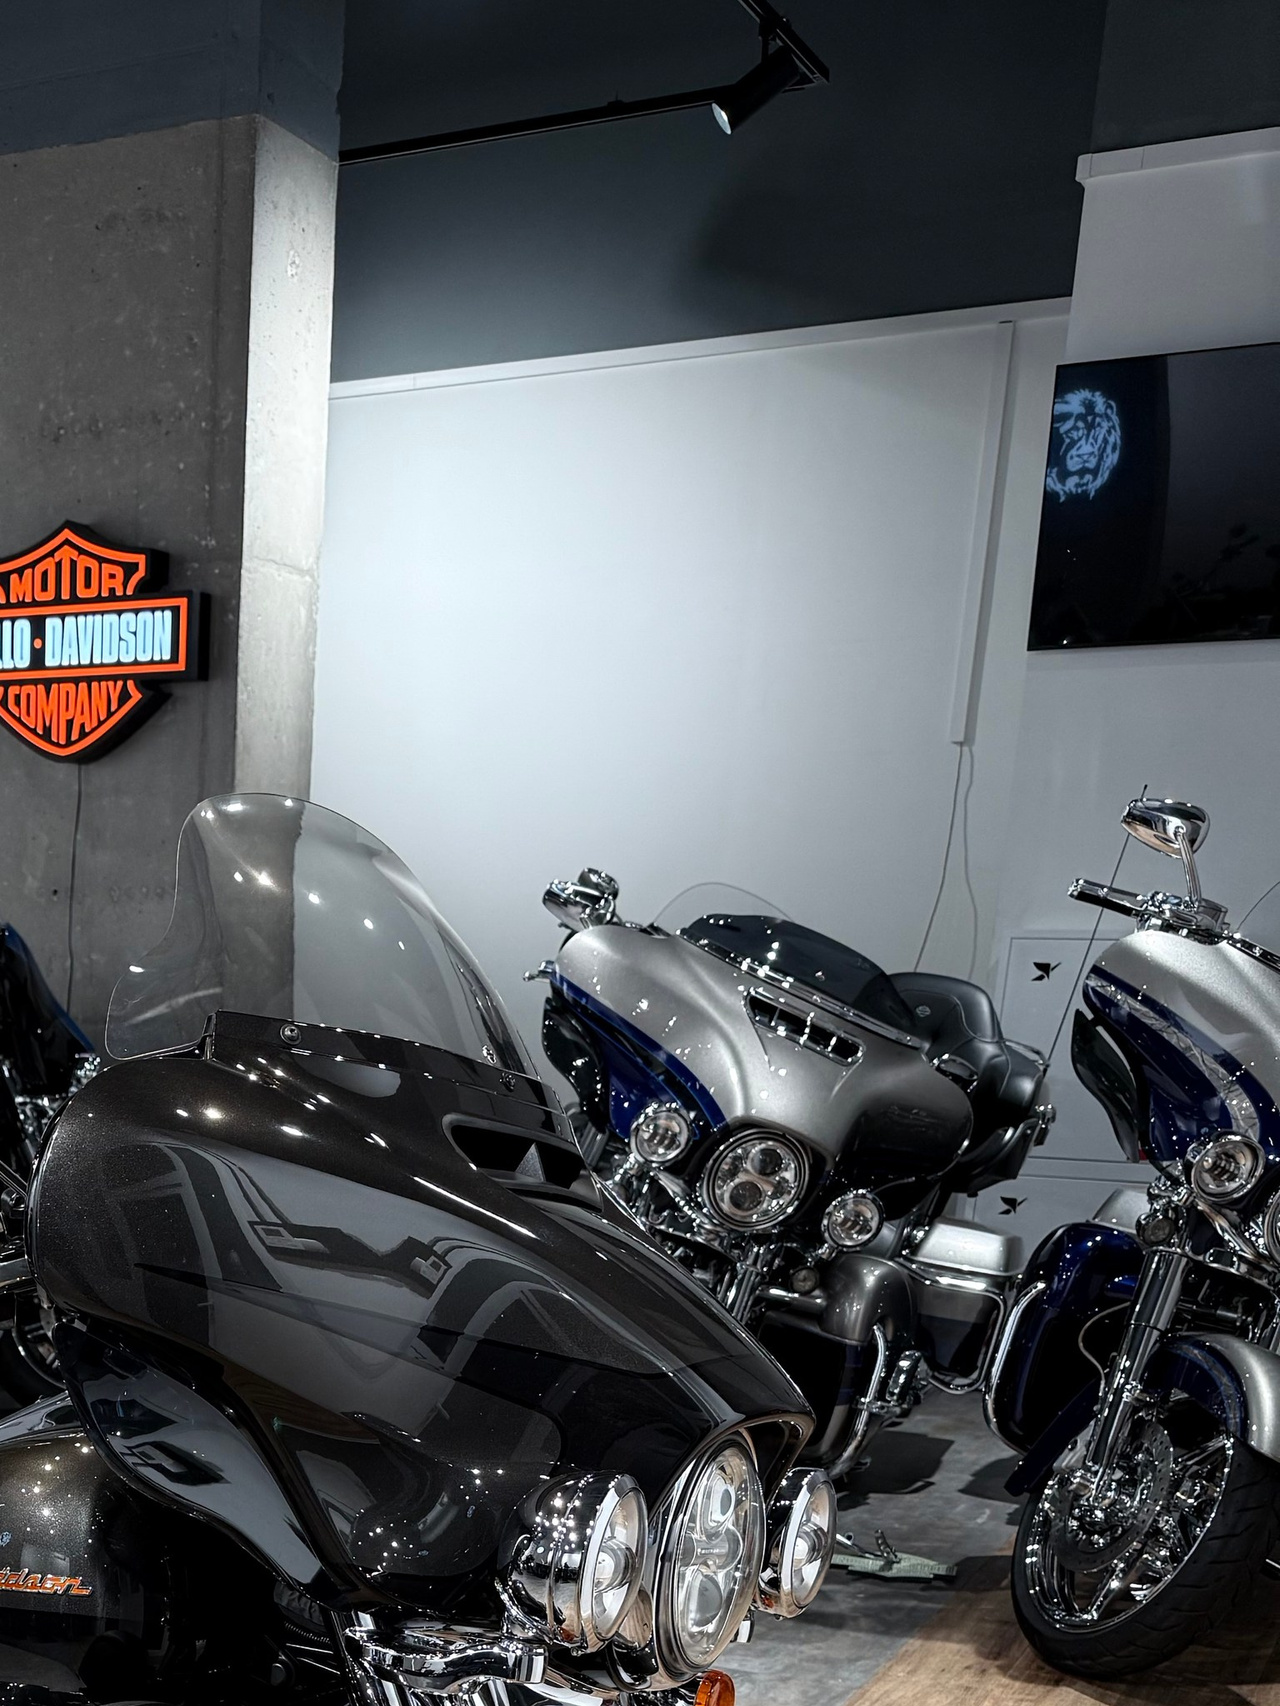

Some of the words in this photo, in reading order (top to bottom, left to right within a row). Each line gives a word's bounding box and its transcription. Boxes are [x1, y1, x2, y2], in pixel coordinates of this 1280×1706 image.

[10, 545, 124, 603] MOTOR
[45, 609, 172, 666] DAVIDSON
[8, 681, 123, 745] COMPANY
